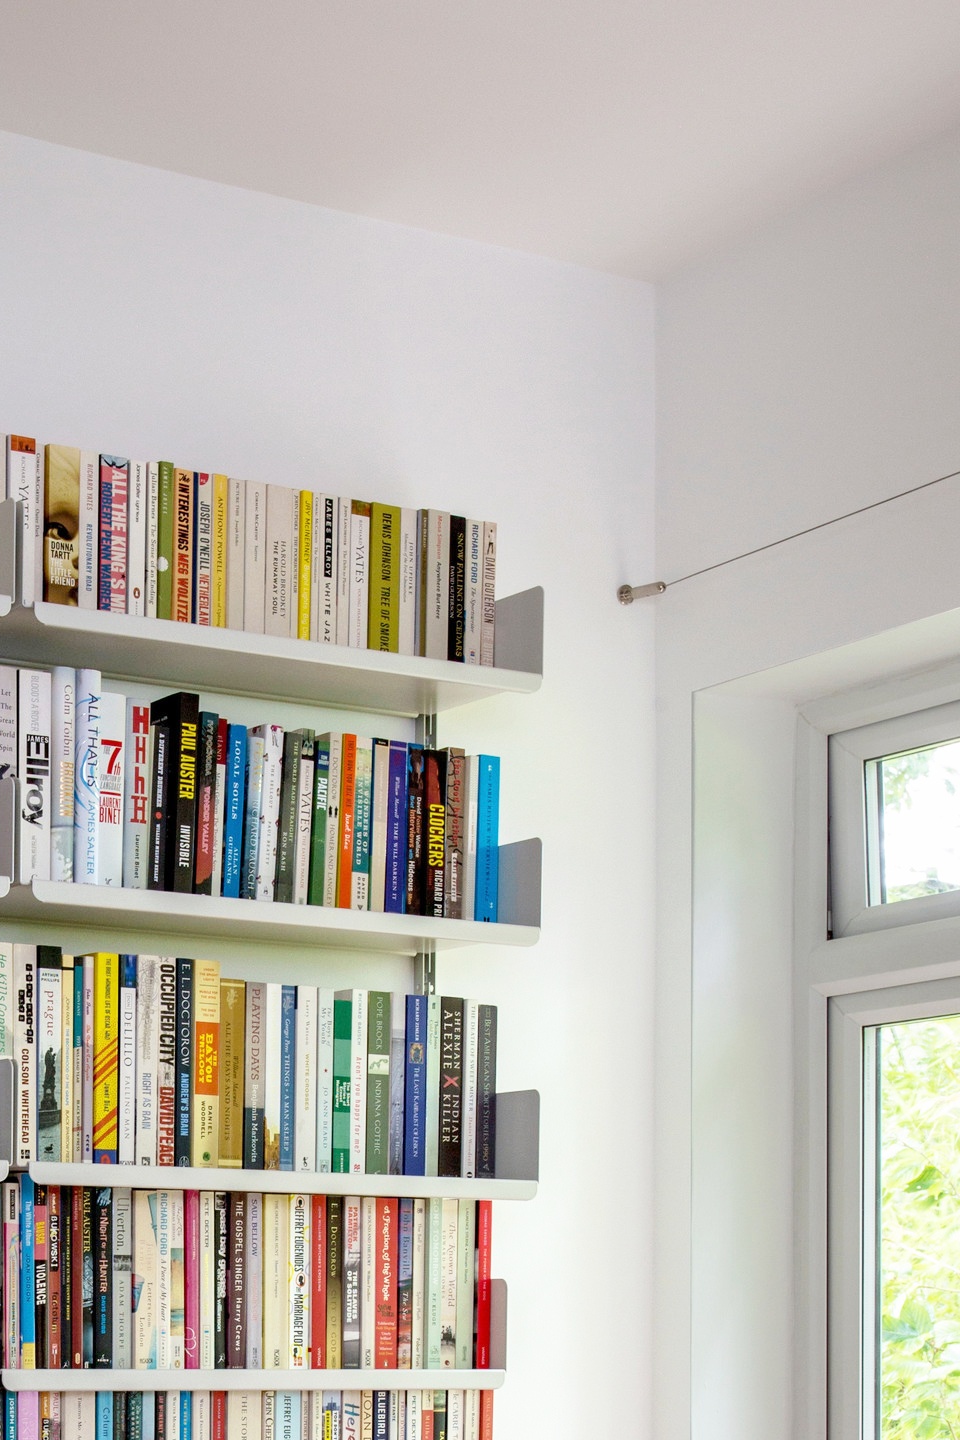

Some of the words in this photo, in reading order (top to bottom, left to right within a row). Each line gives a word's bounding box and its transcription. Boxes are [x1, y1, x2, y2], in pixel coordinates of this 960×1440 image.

[101, 482, 112, 527] ROBERT
[101, 529, 112, 561] PENN
[382, 513, 392, 539] DENIS
[382, 541, 391, 581] JOHNSON
[100, 564, 112, 610] WARREN
[381, 587, 390, 607] TREE
[381, 610, 390, 620] OF
[380, 623, 390, 652] SMOKE
[180, 723, 196, 752] PAUL
[179, 754, 196, 799] AUSTER
[179, 825, 190, 867] INVISIBLE
[429, 804, 444, 866] CLOCKERS
[443, 1010, 453, 1069] ALEXIE
[442, 1094, 450, 1143] KILLER
[235, 1220, 243, 1254] GOSPEL
[36, 1264, 46, 1305] VIOLENCE
[234, 1298, 242, 1322] Harry
[283, 1395, 291, 1423] JEFFREY
[376, 1392, 386, 1437] BLUEBIRD,
